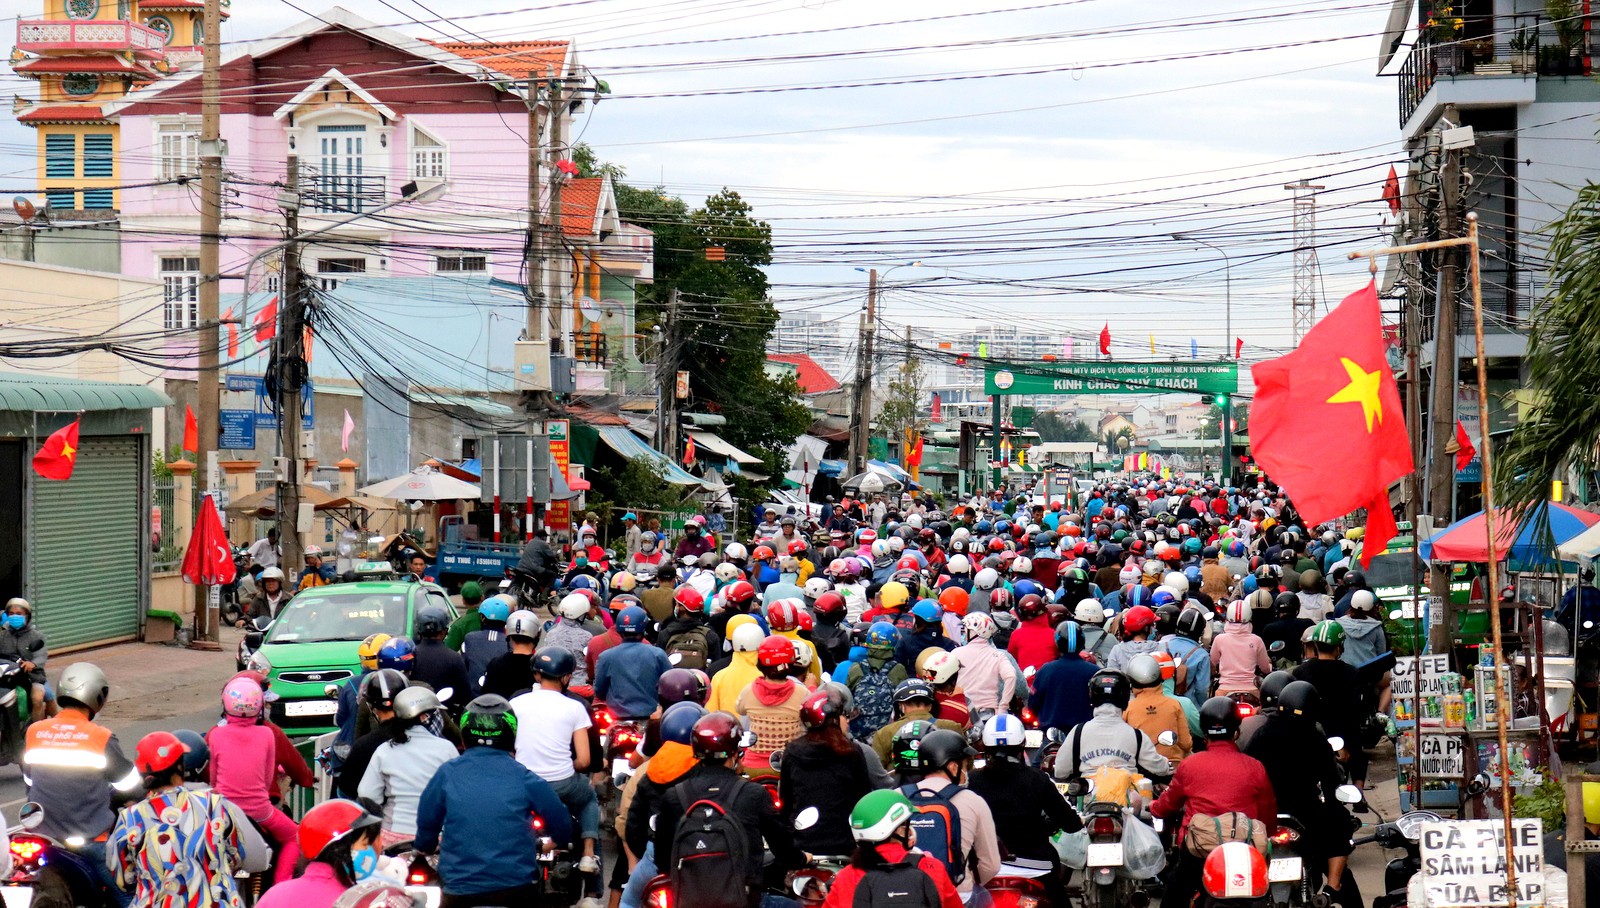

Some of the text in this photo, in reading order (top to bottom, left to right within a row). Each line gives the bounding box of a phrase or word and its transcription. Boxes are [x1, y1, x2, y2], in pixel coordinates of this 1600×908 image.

[1090, 367, 1106, 376] DỊCH
[1118, 365, 1136, 374] CÔNG
[1150, 366, 1172, 374] THANH
[1125, 376, 1151, 391] QUÝ
[1155, 375, 1198, 389] KHÁCH
[1392, 657, 1447, 676] CAFE
[1096, 748, 1132, 762] EXCHANGE
[1421, 737, 1442, 755] CÀ
[1421, 756, 1441, 774] NƯỚC
[1424, 823, 1539, 850] CÀ PHÊ
[1425, 853, 1540, 877] SÂM LẠNH
